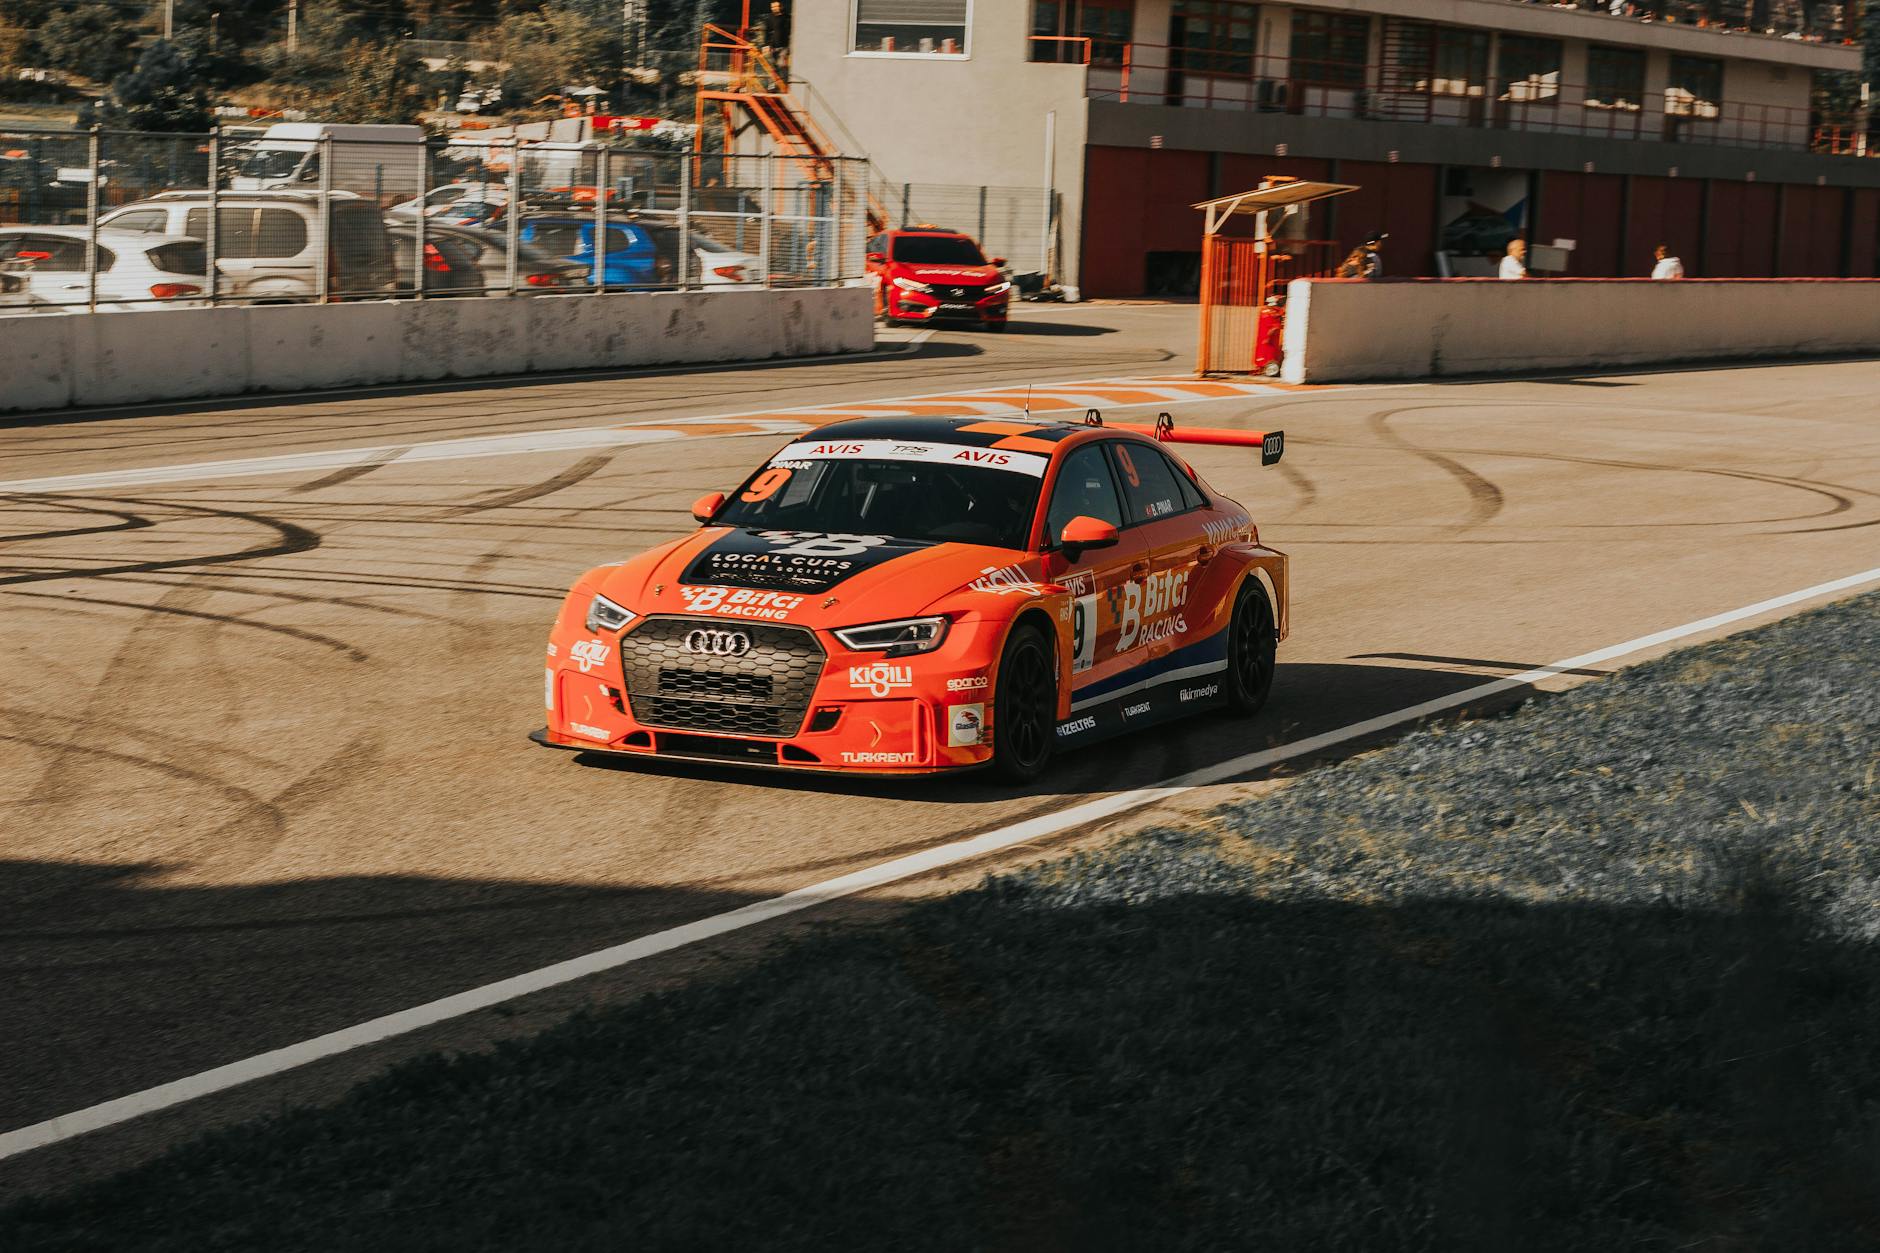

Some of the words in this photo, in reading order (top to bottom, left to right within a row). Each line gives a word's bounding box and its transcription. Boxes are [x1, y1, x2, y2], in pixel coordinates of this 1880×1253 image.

[809, 444, 865, 455] AVIS
[953, 450, 1011, 465] AVIS
[1115, 443, 1141, 488] 9
[740, 468, 793, 503] 9
[711, 553, 783, 564] LOCAL
[791, 557, 852, 570] CUPS
[712, 562, 767, 571] COFFEE
[777, 566, 841, 577] SOCIETY
[726, 590, 804, 610] Bitci
[1144, 569, 1189, 617] Bitci
[717, 604, 790, 620] RACING
[1138, 613, 1188, 647] RACING
[947, 677, 989, 691] sparco
[1179, 683, 1219, 702] fikirmedya
[840, 752, 915, 763] TURKRENT
